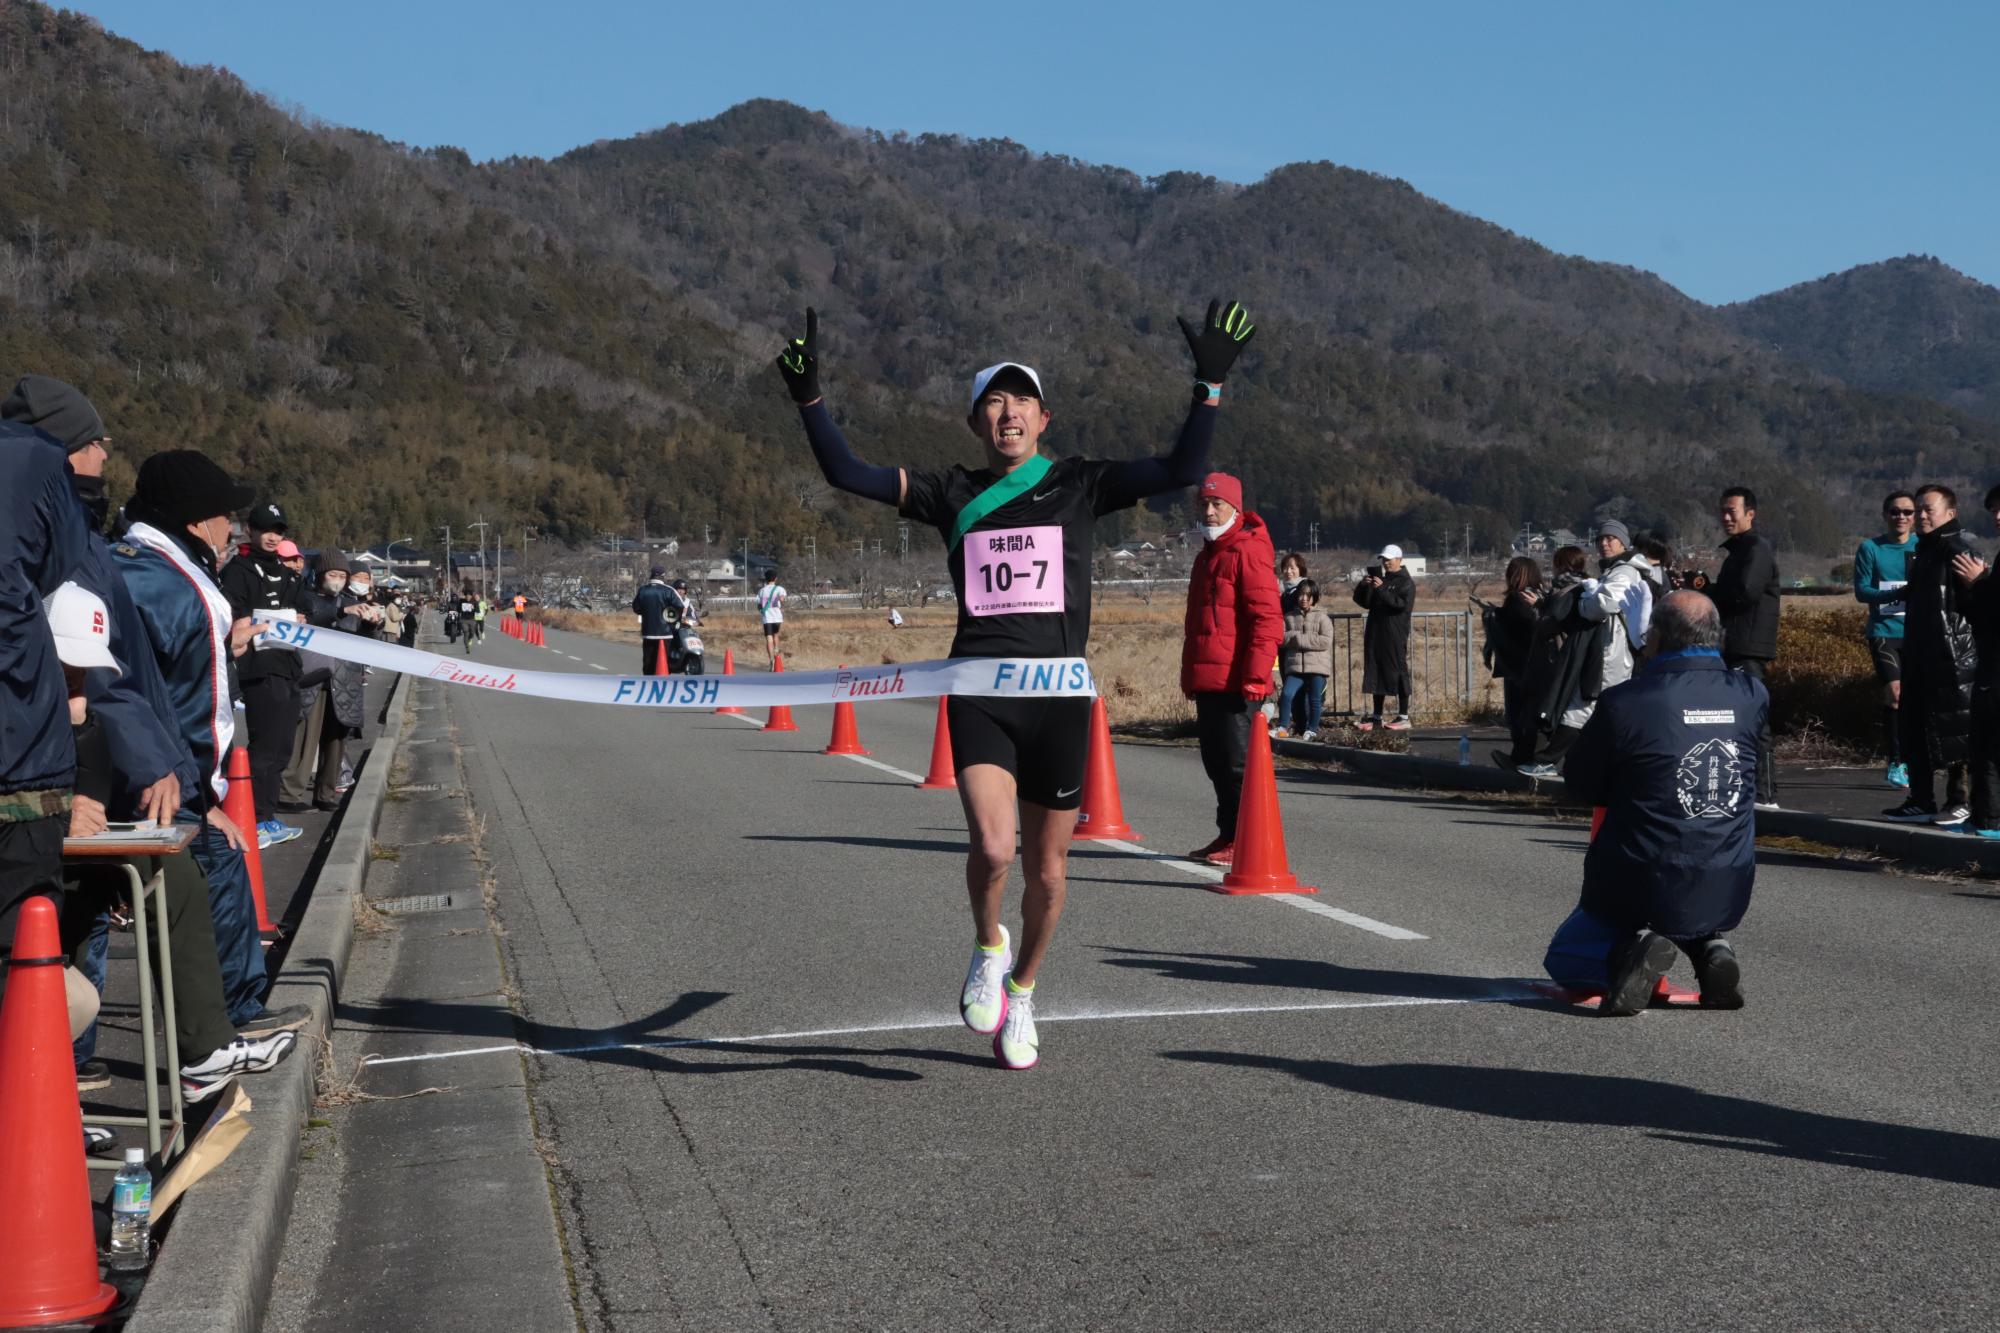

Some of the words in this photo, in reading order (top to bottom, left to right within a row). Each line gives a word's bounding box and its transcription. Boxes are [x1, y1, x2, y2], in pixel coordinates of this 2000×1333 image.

[989, 535, 1035, 553] 味間A
[979, 560, 1048, 593] 10-7
[428, 661, 516, 690] Finish
[613, 680, 720, 704] FINISH
[832, 668, 905, 698] Finish
[1708, 756, 1719, 800] 丹波篠山
